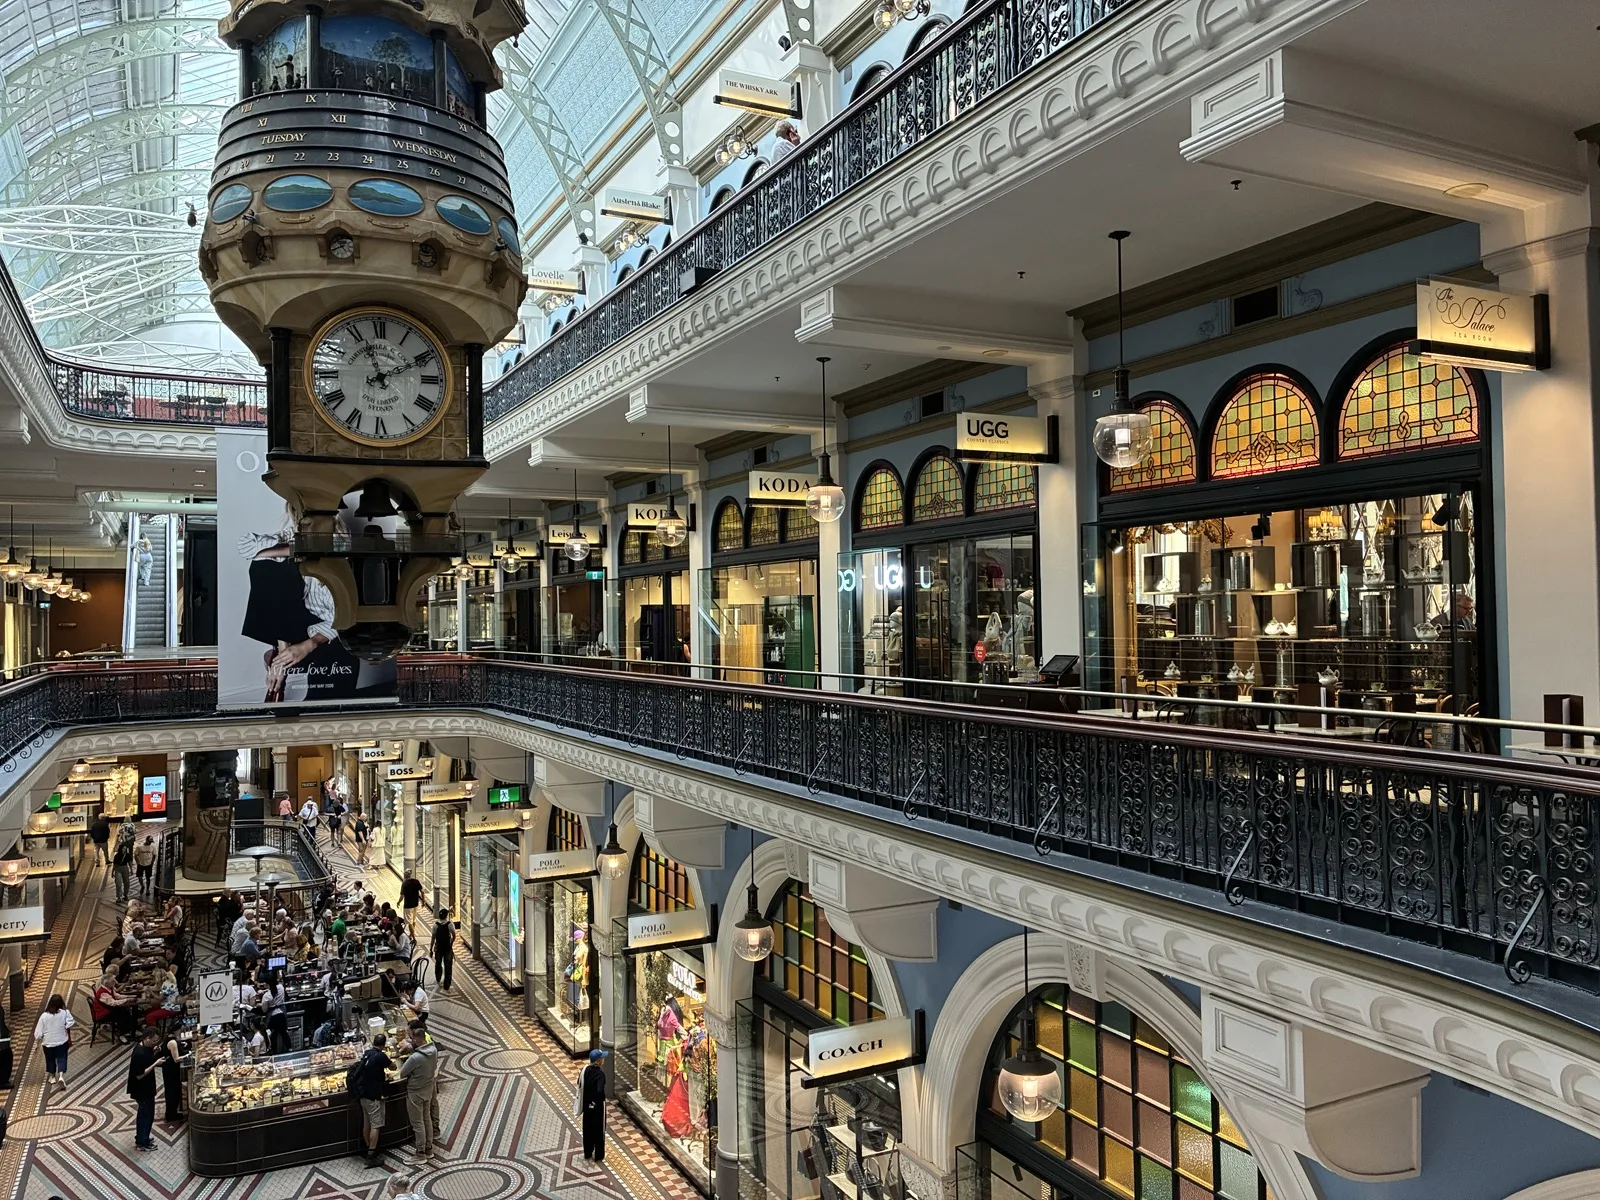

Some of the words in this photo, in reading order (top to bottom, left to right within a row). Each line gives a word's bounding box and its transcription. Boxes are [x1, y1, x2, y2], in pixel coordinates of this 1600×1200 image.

[725, 80, 738, 88] THE
[739, 84, 764, 93] WHISKY
[305, 94, 317, 103] IX
[389, 101, 397, 111] X
[457, 121, 468, 133] XI
[257, 118, 268, 128] XI
[331, 114, 347, 123] XII
[261, 132, 307, 145] TUESDAY
[392, 139, 457, 163] WEDNESDAY
[266, 154, 275, 164] 21
[293, 152, 306, 161] 22
[327, 152, 340, 161] 23
[362, 155, 374, 164] 24
[397, 160, 409, 169] 25
[429, 167, 441, 177] 26
[531, 268, 565, 280] Lovelle
[1441, 297, 1510, 332] Palace
[372, 320, 386, 339] XII
[420, 374, 439, 384] III
[368, 403, 394, 411] SYDNEY
[967, 419, 1009, 438] UGG
[759, 477, 811, 493] KODA
[635, 508, 668, 520] KOD
[267, 664, 304, 676] Where
[304, 662, 328, 677] love
[364, 750, 385, 758] BOSS
[389, 767, 414, 776] BOSS
[63, 816, 84, 824] apm
[468, 821, 500, 829] SWAROVSKI
[540, 859, 560, 867] POLO
[641, 923, 666, 934] POLO
[672, 960, 697, 988] POLO
[818, 1039, 883, 1061] COACH
